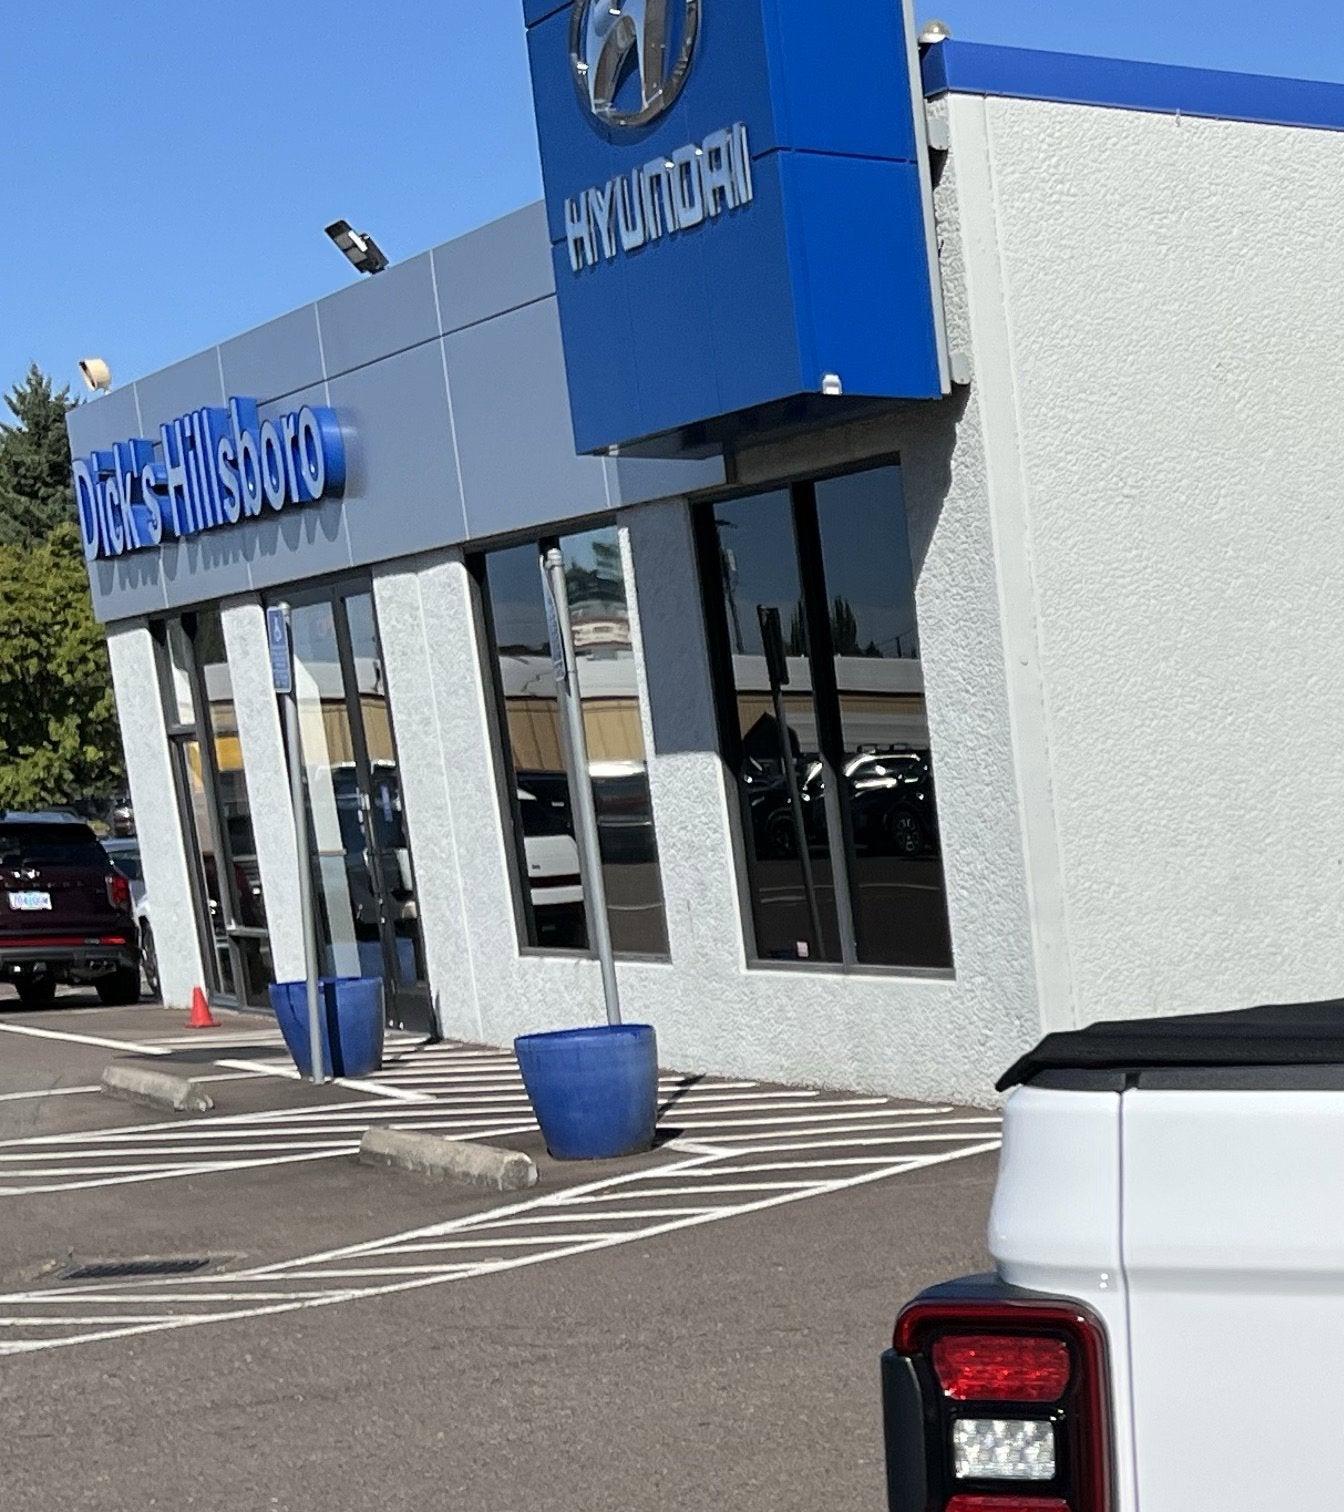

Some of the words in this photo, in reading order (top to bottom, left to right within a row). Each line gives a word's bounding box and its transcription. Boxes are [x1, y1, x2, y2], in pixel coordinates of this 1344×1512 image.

[564, 121, 753, 272] HYUNDAI
[72, 437, 163, 561] Dick's
[160, 396, 334, 537] Hillsboro
